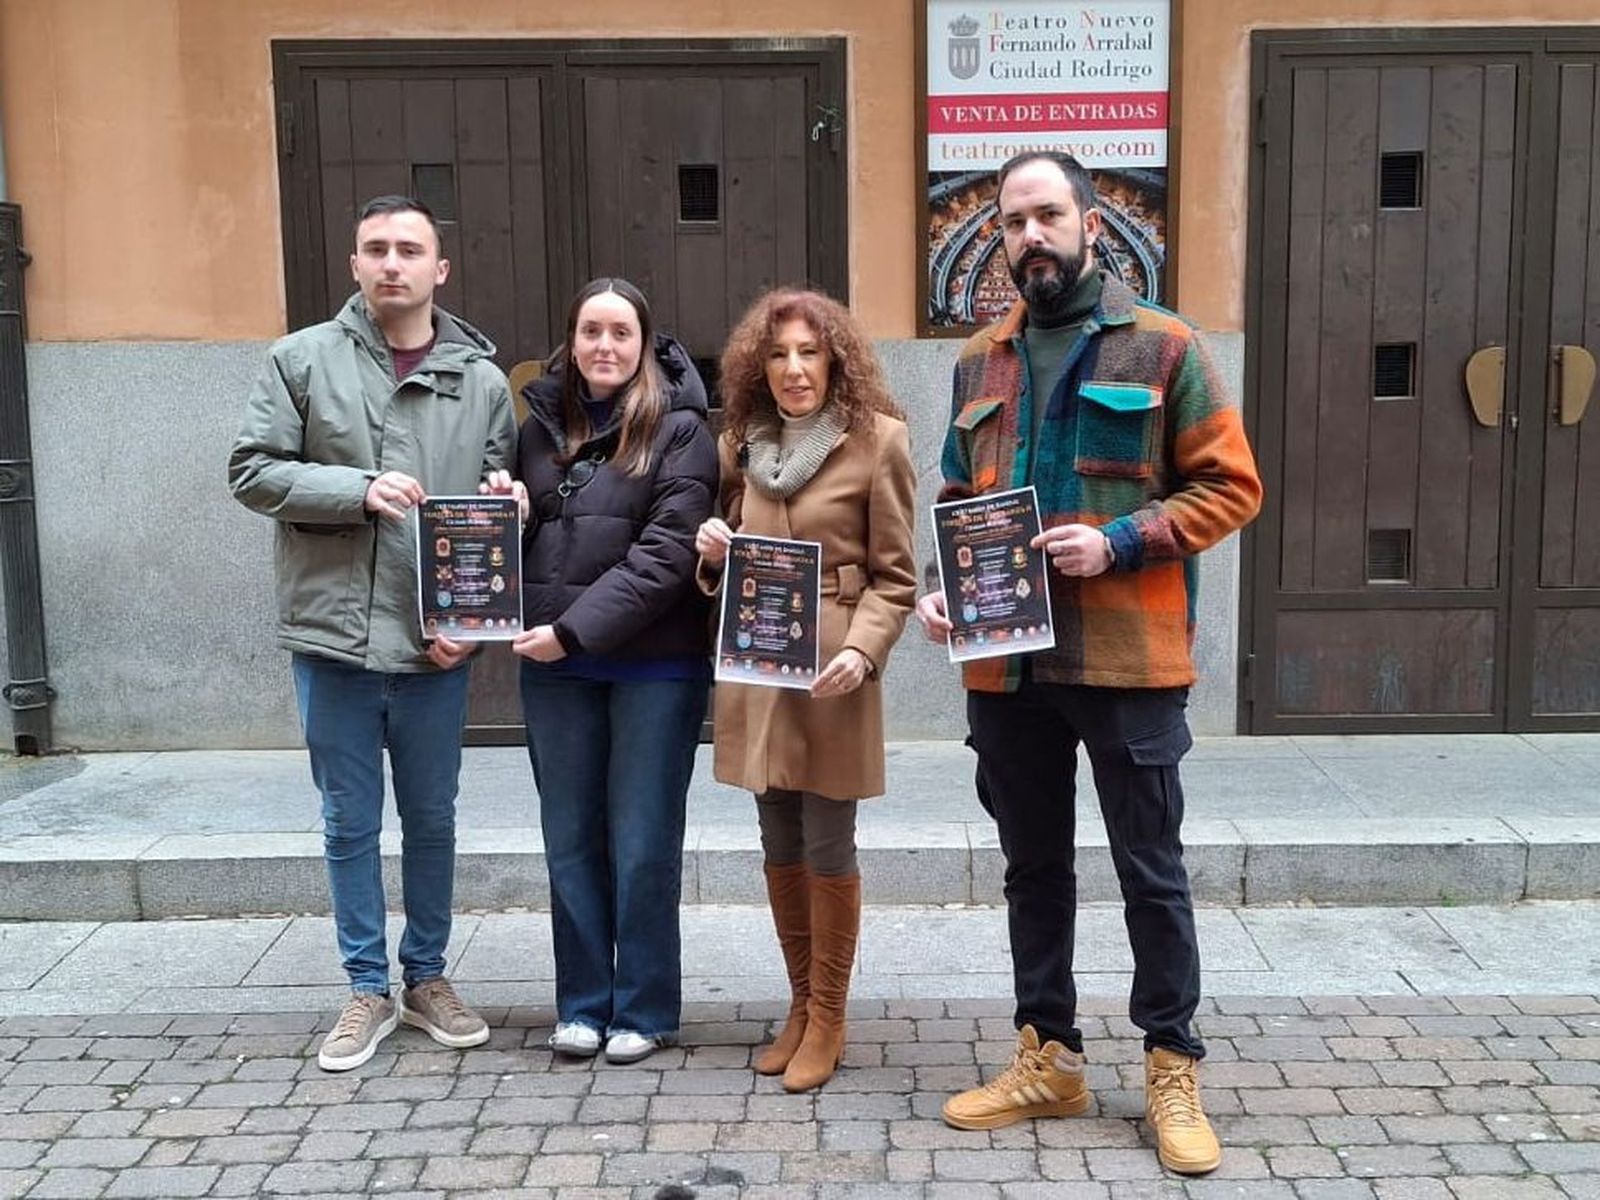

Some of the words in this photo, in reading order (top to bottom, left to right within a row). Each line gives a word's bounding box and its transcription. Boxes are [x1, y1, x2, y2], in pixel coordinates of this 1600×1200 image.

[990, 12, 1067, 30] Teatro
[1080, 11, 1154, 29] Nuevo
[989, 34, 1076, 53] Fernando
[1083, 32, 1153, 51] Arrabal
[989, 61, 1061, 80] Ciudad
[1072, 59, 1153, 83] Rodrigo
[940, 106, 1008, 123] VENTA
[1015, 104, 1043, 121] DE
[1049, 103, 1158, 120] ENTRADAS
